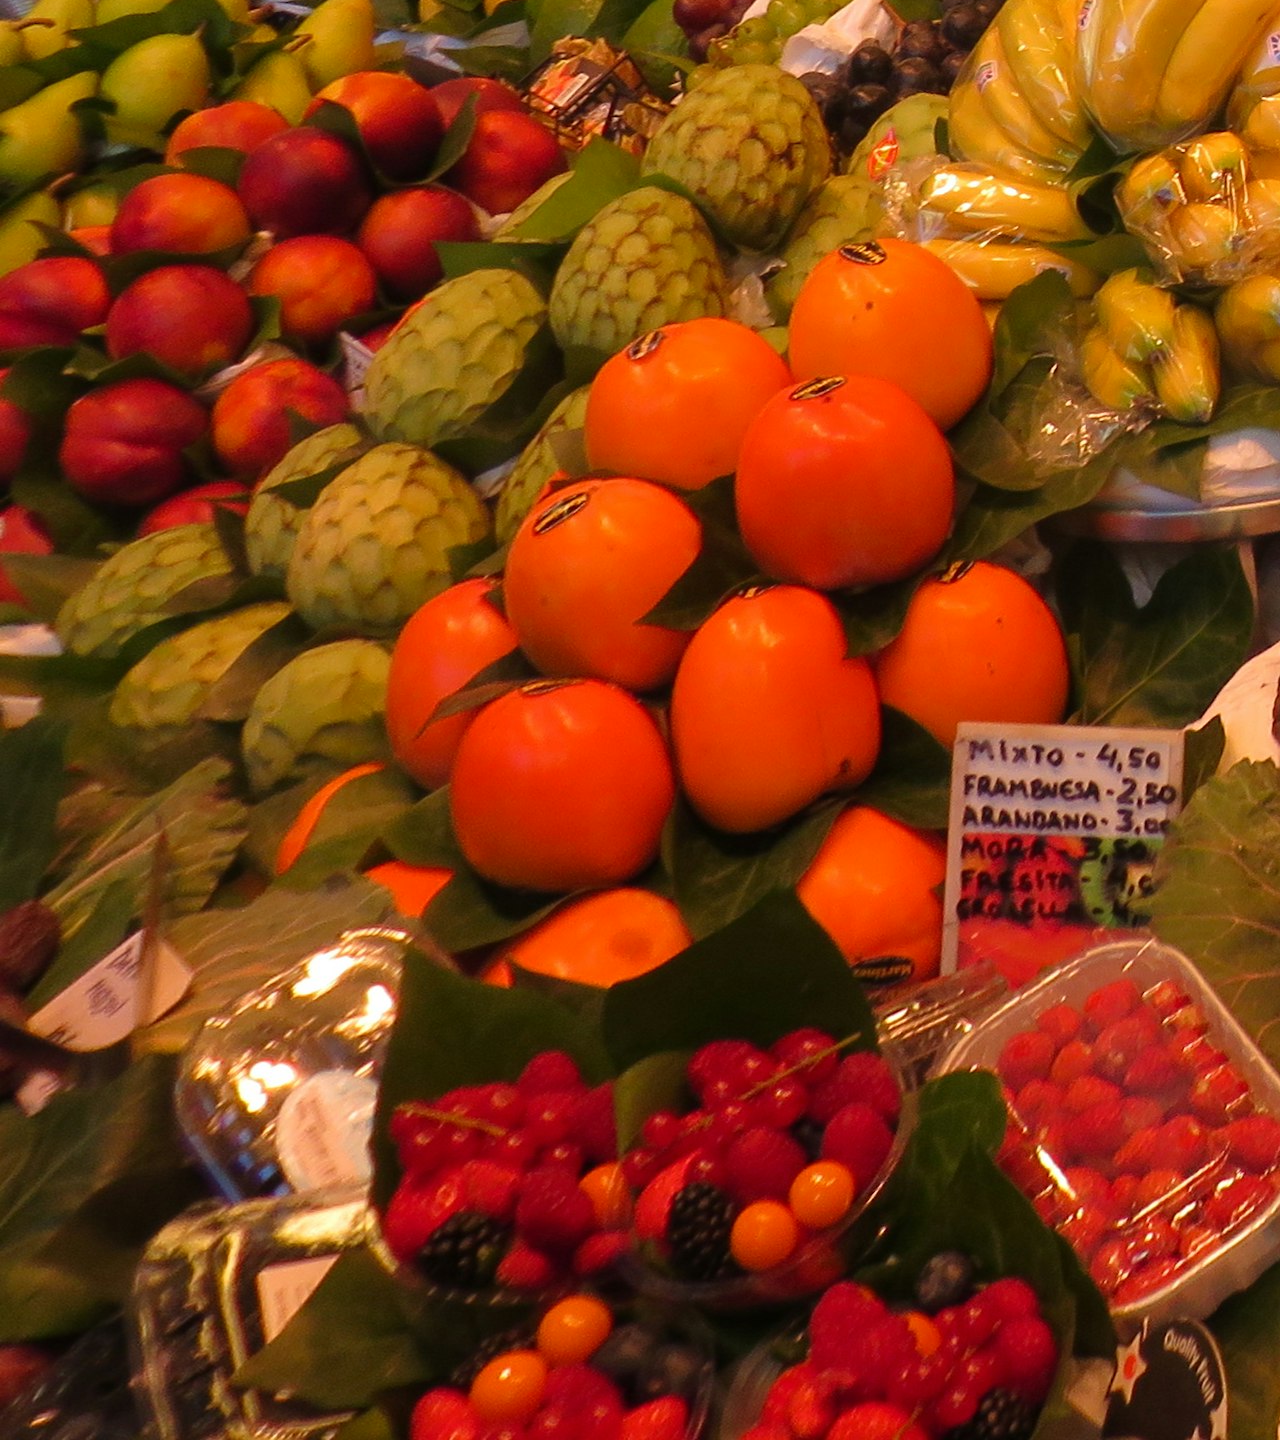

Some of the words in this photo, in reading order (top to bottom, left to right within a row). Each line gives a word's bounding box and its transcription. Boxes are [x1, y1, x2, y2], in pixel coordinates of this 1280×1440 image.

[968, 739, 1065, 768] MIXTO
[1096, 741, 1162, 773] 4,50
[962, 773, 1101, 804] FRAMBUESA
[1115, 777, 1178, 810] 2,50
[962, 805, 1099, 831] ARANDANO
[1162, 1327, 1202, 1371] Quality
[1195, 1357, 1217, 1406] Fruit
